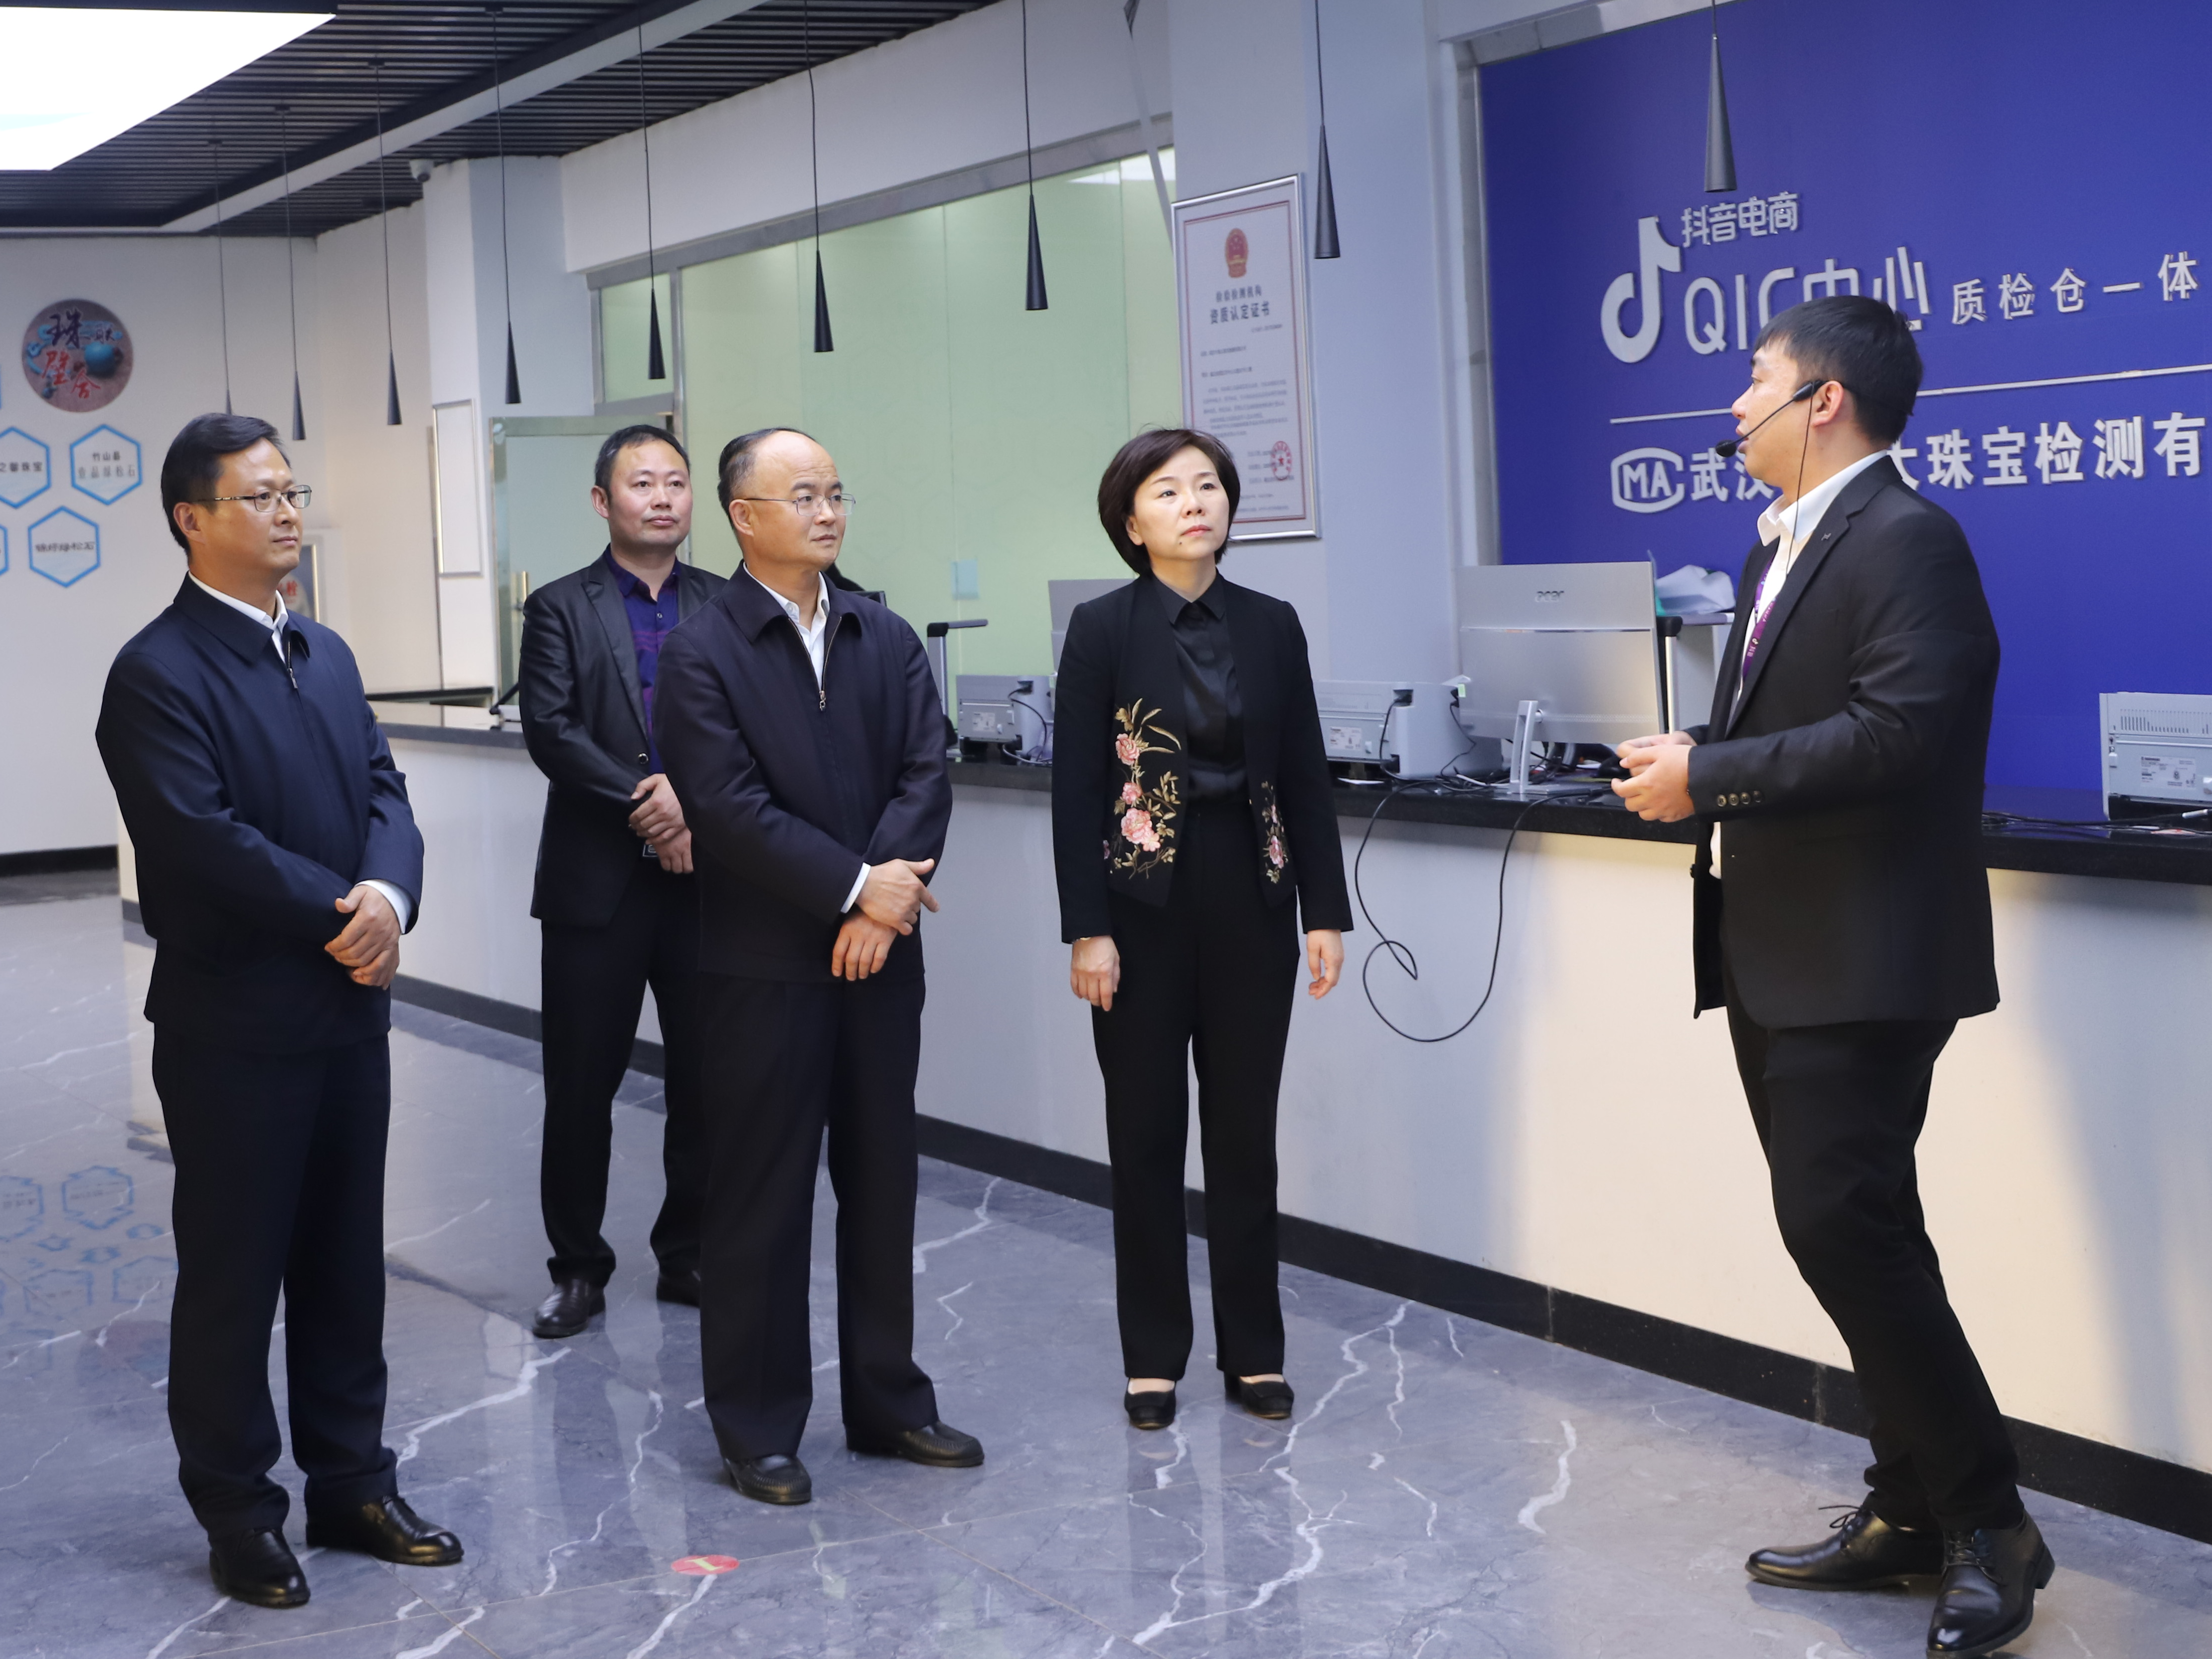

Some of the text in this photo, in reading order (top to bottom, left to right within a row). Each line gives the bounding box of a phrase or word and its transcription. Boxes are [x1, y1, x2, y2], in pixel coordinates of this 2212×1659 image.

[1681, 191, 1798, 248] 抖音电商
[1210, 301, 1270, 324] 资质认定证书
[1951, 251, 2198, 325] 质检仓一体
